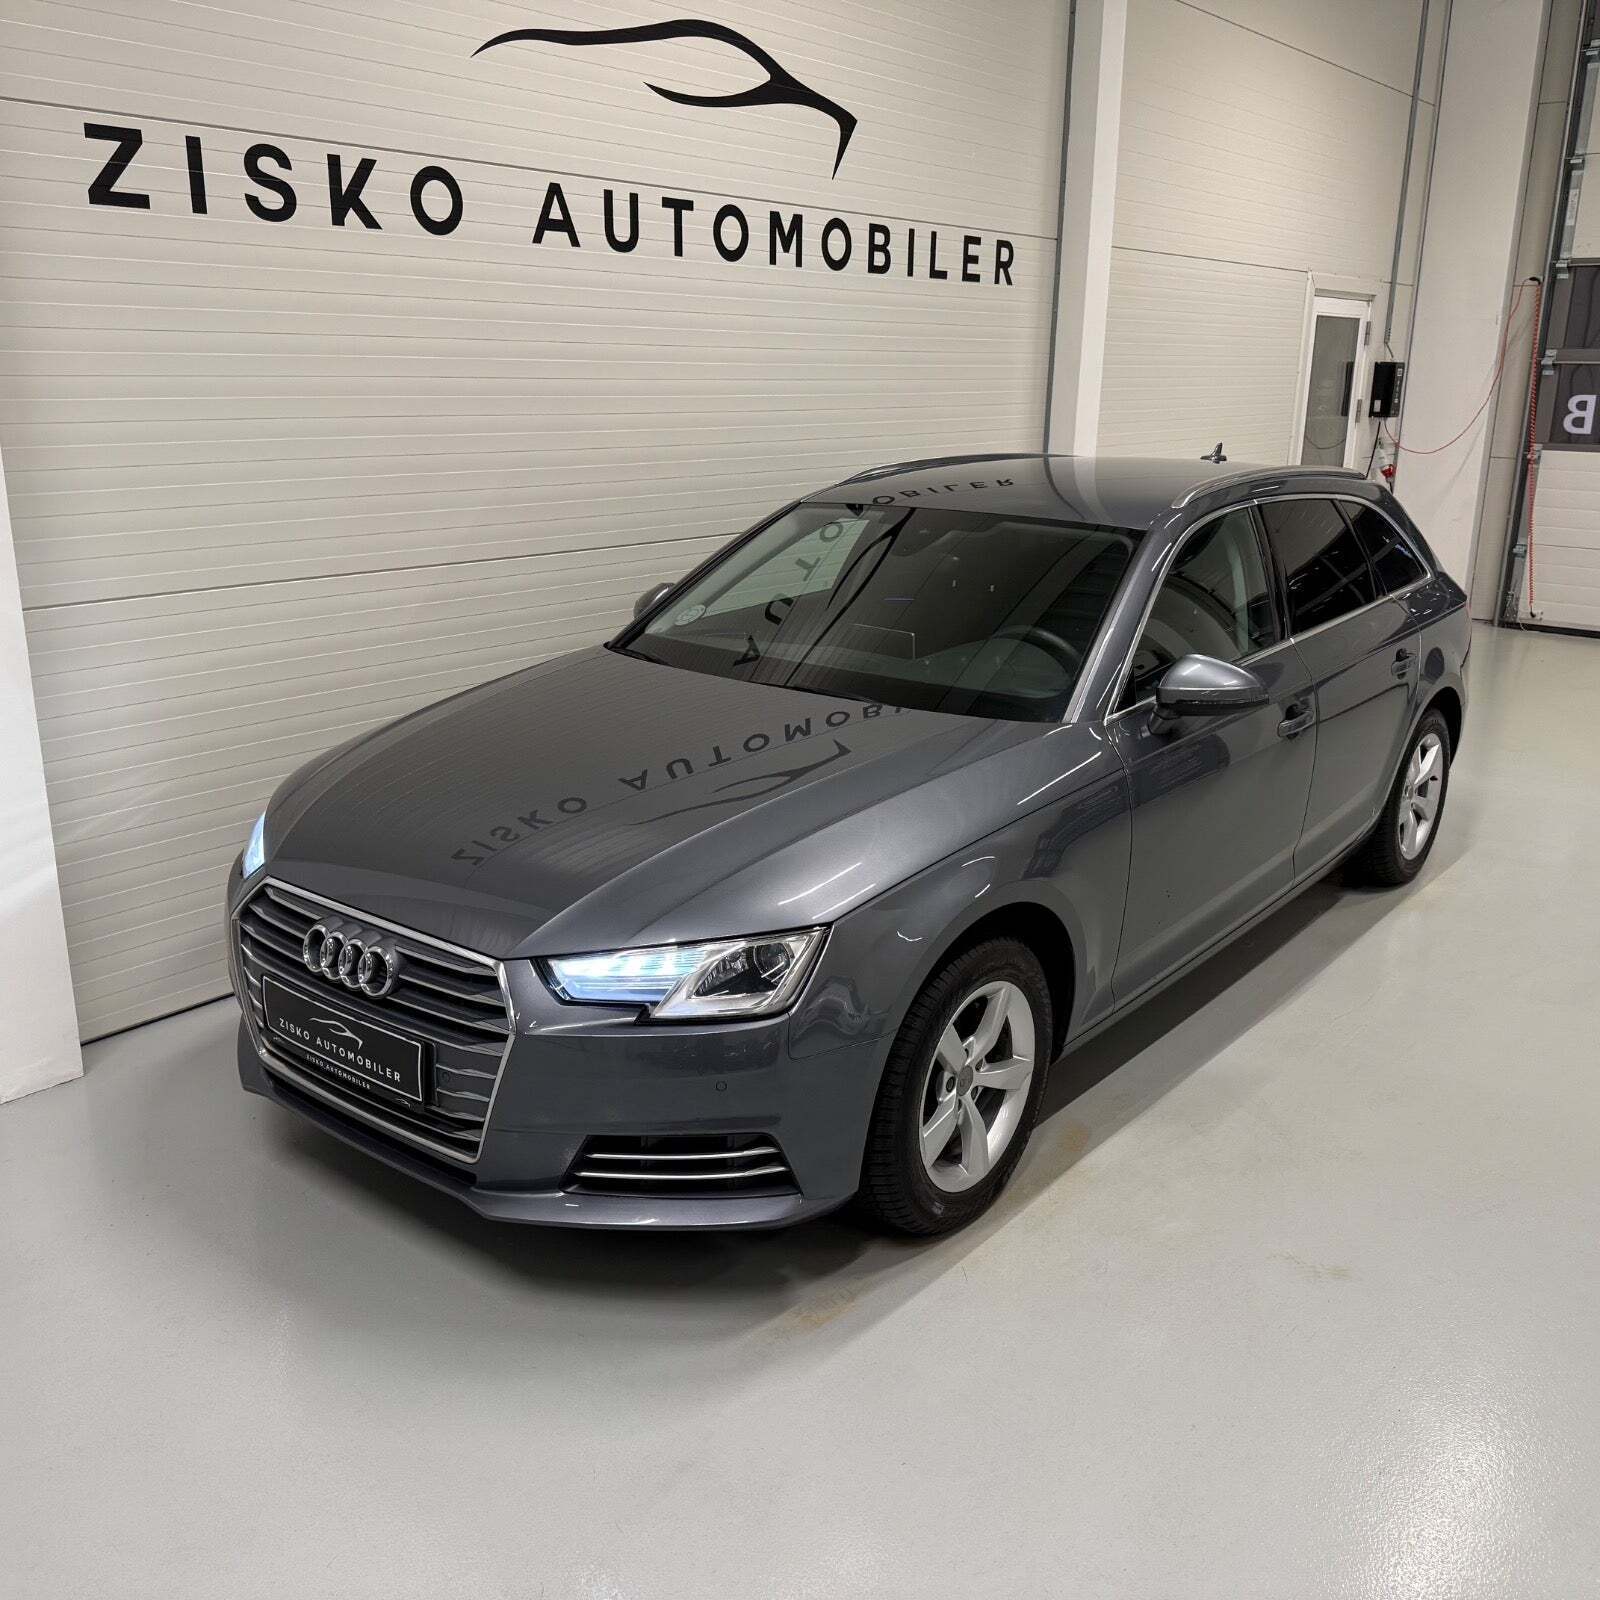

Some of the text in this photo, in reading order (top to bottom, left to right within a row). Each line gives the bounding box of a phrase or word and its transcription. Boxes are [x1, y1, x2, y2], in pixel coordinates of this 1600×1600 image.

[83, 122, 1014, 286] ZISKO AUTOMOBILER
[279, 1017, 401, 1082] ZISKO AUTOMOBILER
